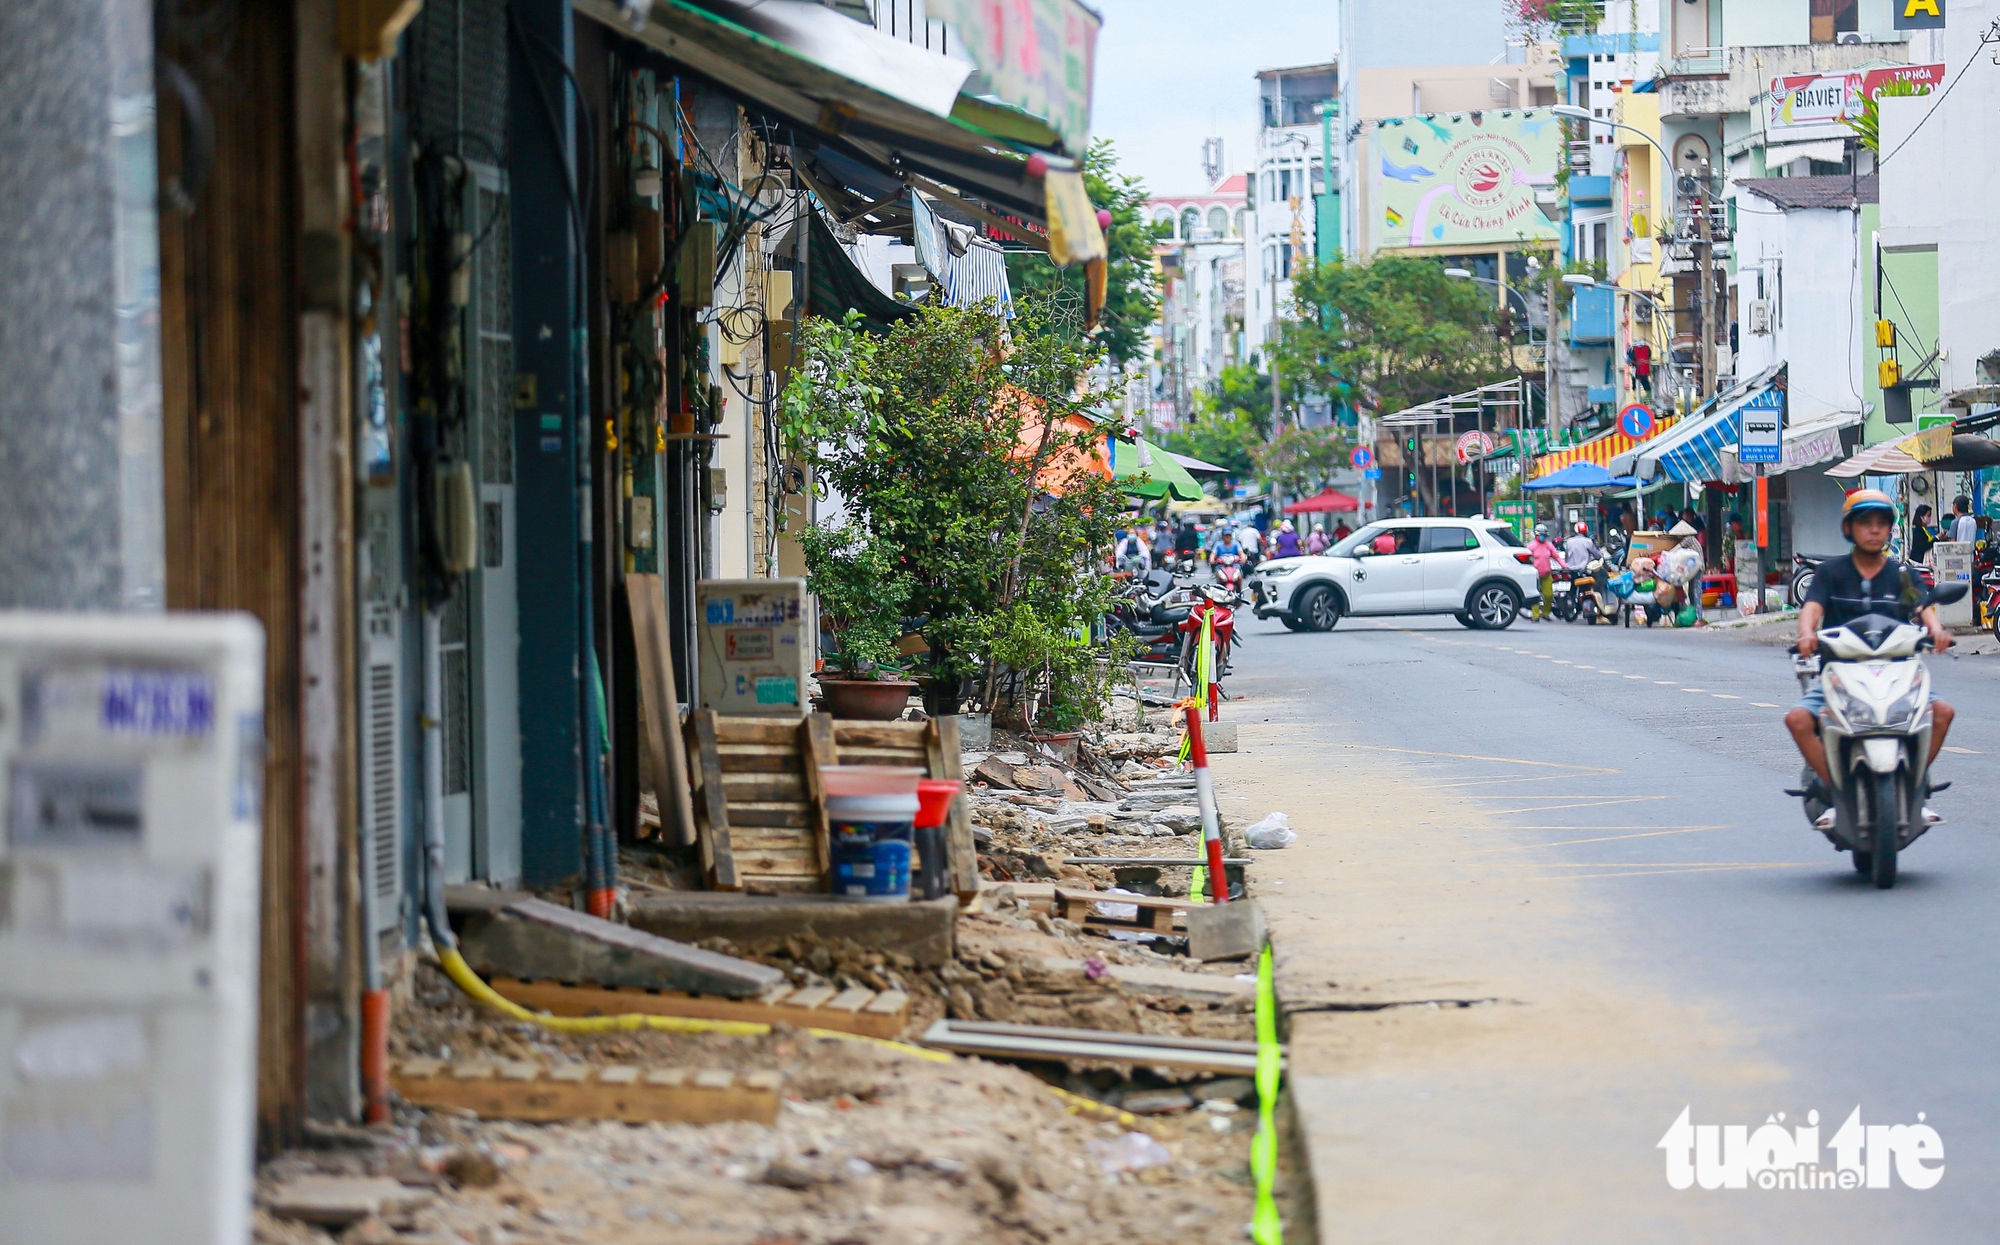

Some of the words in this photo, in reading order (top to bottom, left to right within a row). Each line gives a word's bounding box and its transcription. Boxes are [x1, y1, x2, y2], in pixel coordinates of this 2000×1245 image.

[1912, 67, 1932, 80] HÓA
[1796, 89, 1815, 108] BIA
[1815, 87, 1842, 108] VIỆT
[1459, 150, 1511, 176] HIGHLANDS
[1465, 192, 1505, 206] COFFEE
